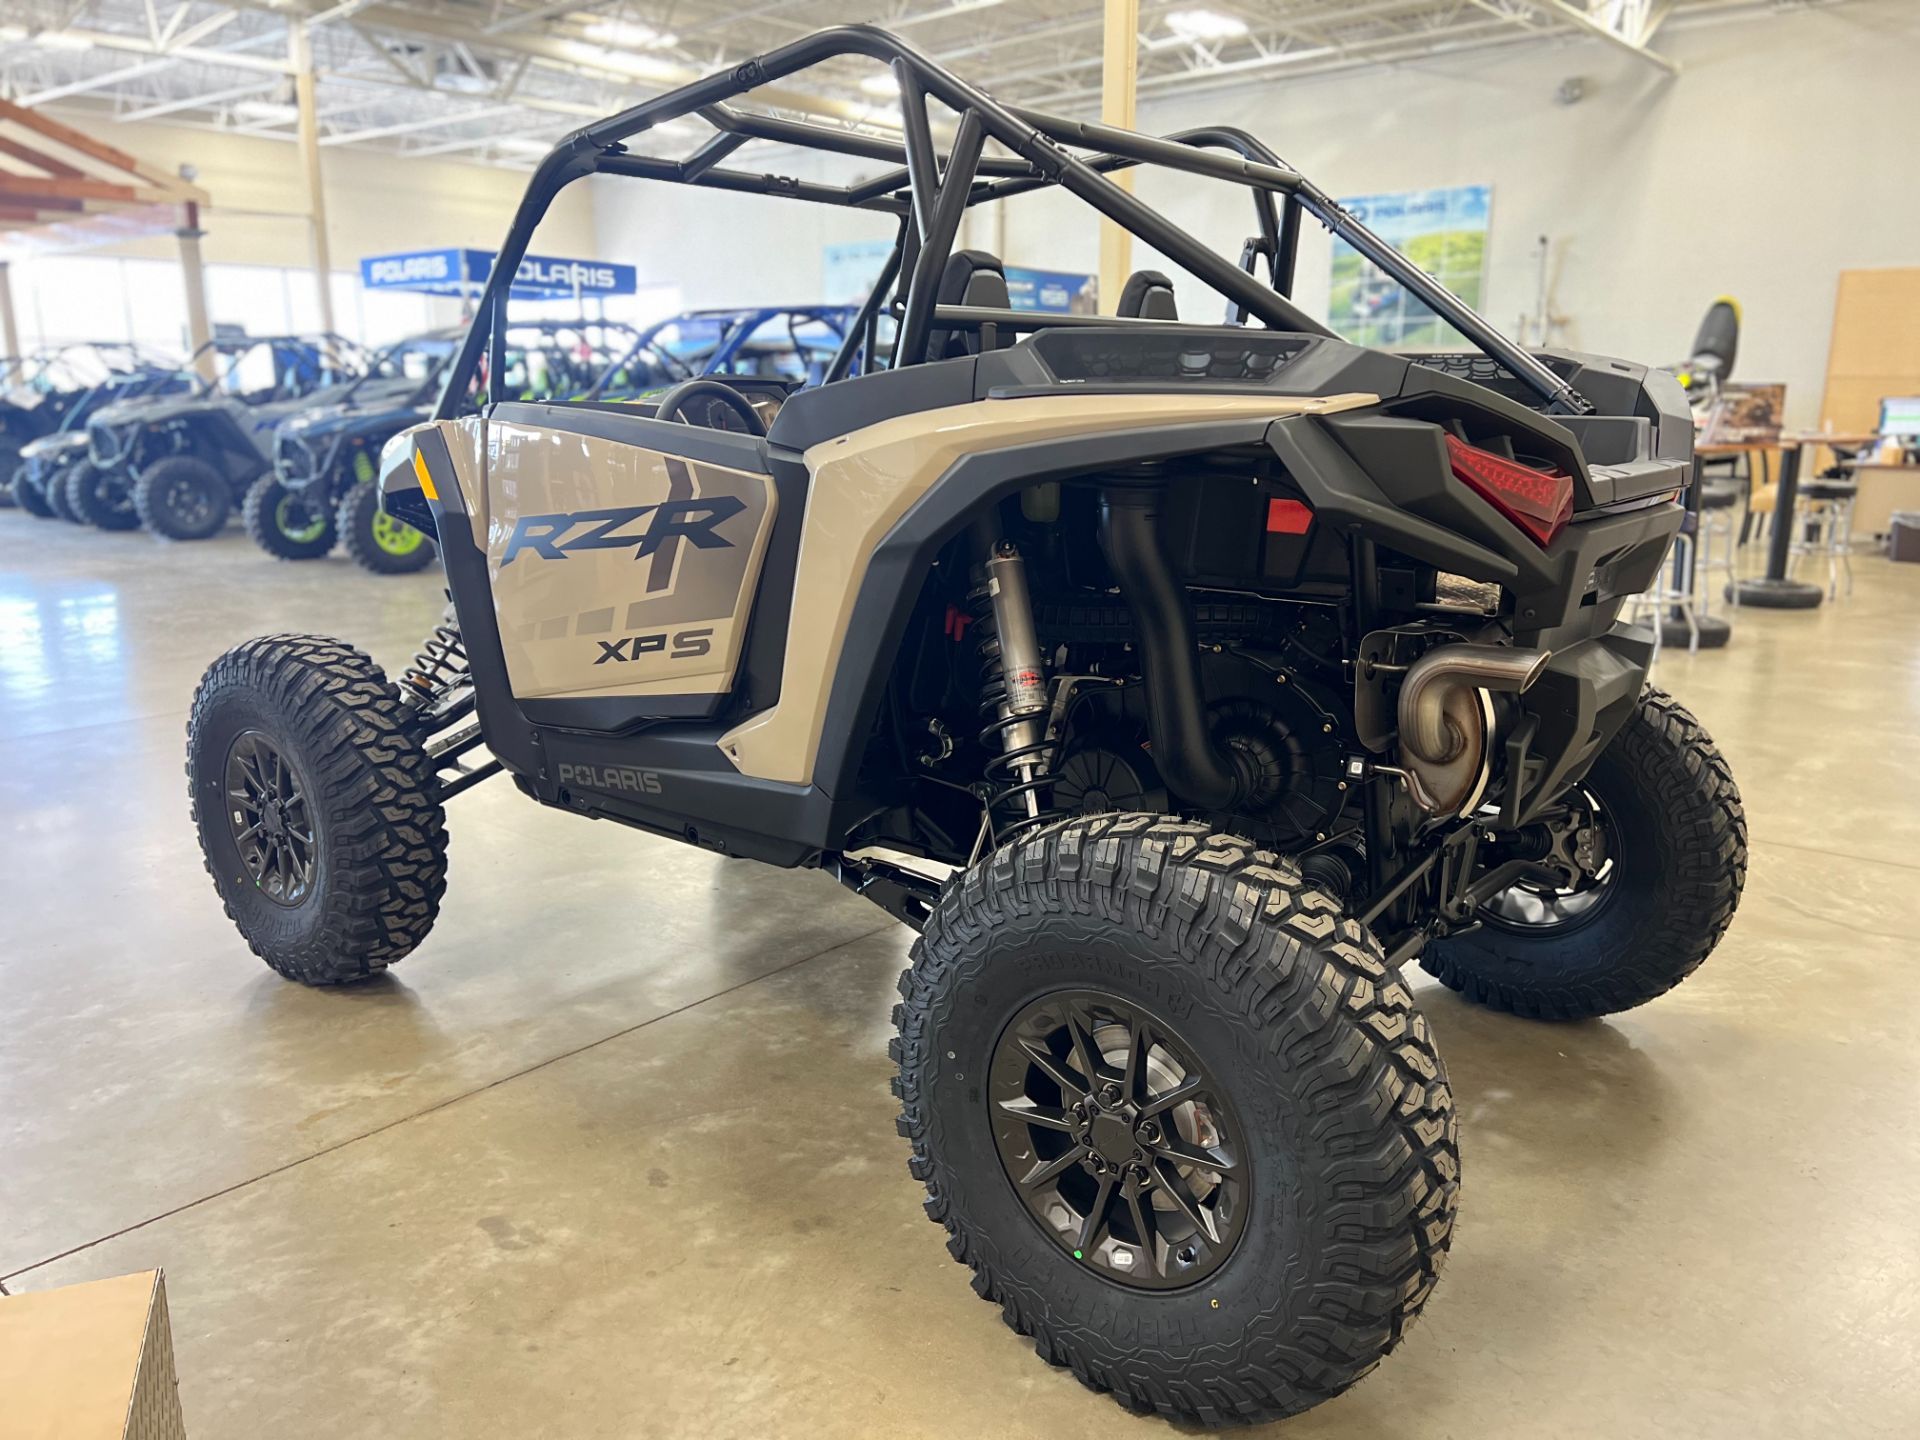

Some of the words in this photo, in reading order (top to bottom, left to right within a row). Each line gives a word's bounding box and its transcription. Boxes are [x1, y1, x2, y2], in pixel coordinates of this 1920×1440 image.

[370, 255, 448, 284] POLARIS
[491, 257, 616, 289] OLARIS
[499, 495, 747, 568] RZR
[558, 763, 662, 794] POLARIS
[1014, 949, 1065, 976] PRO
